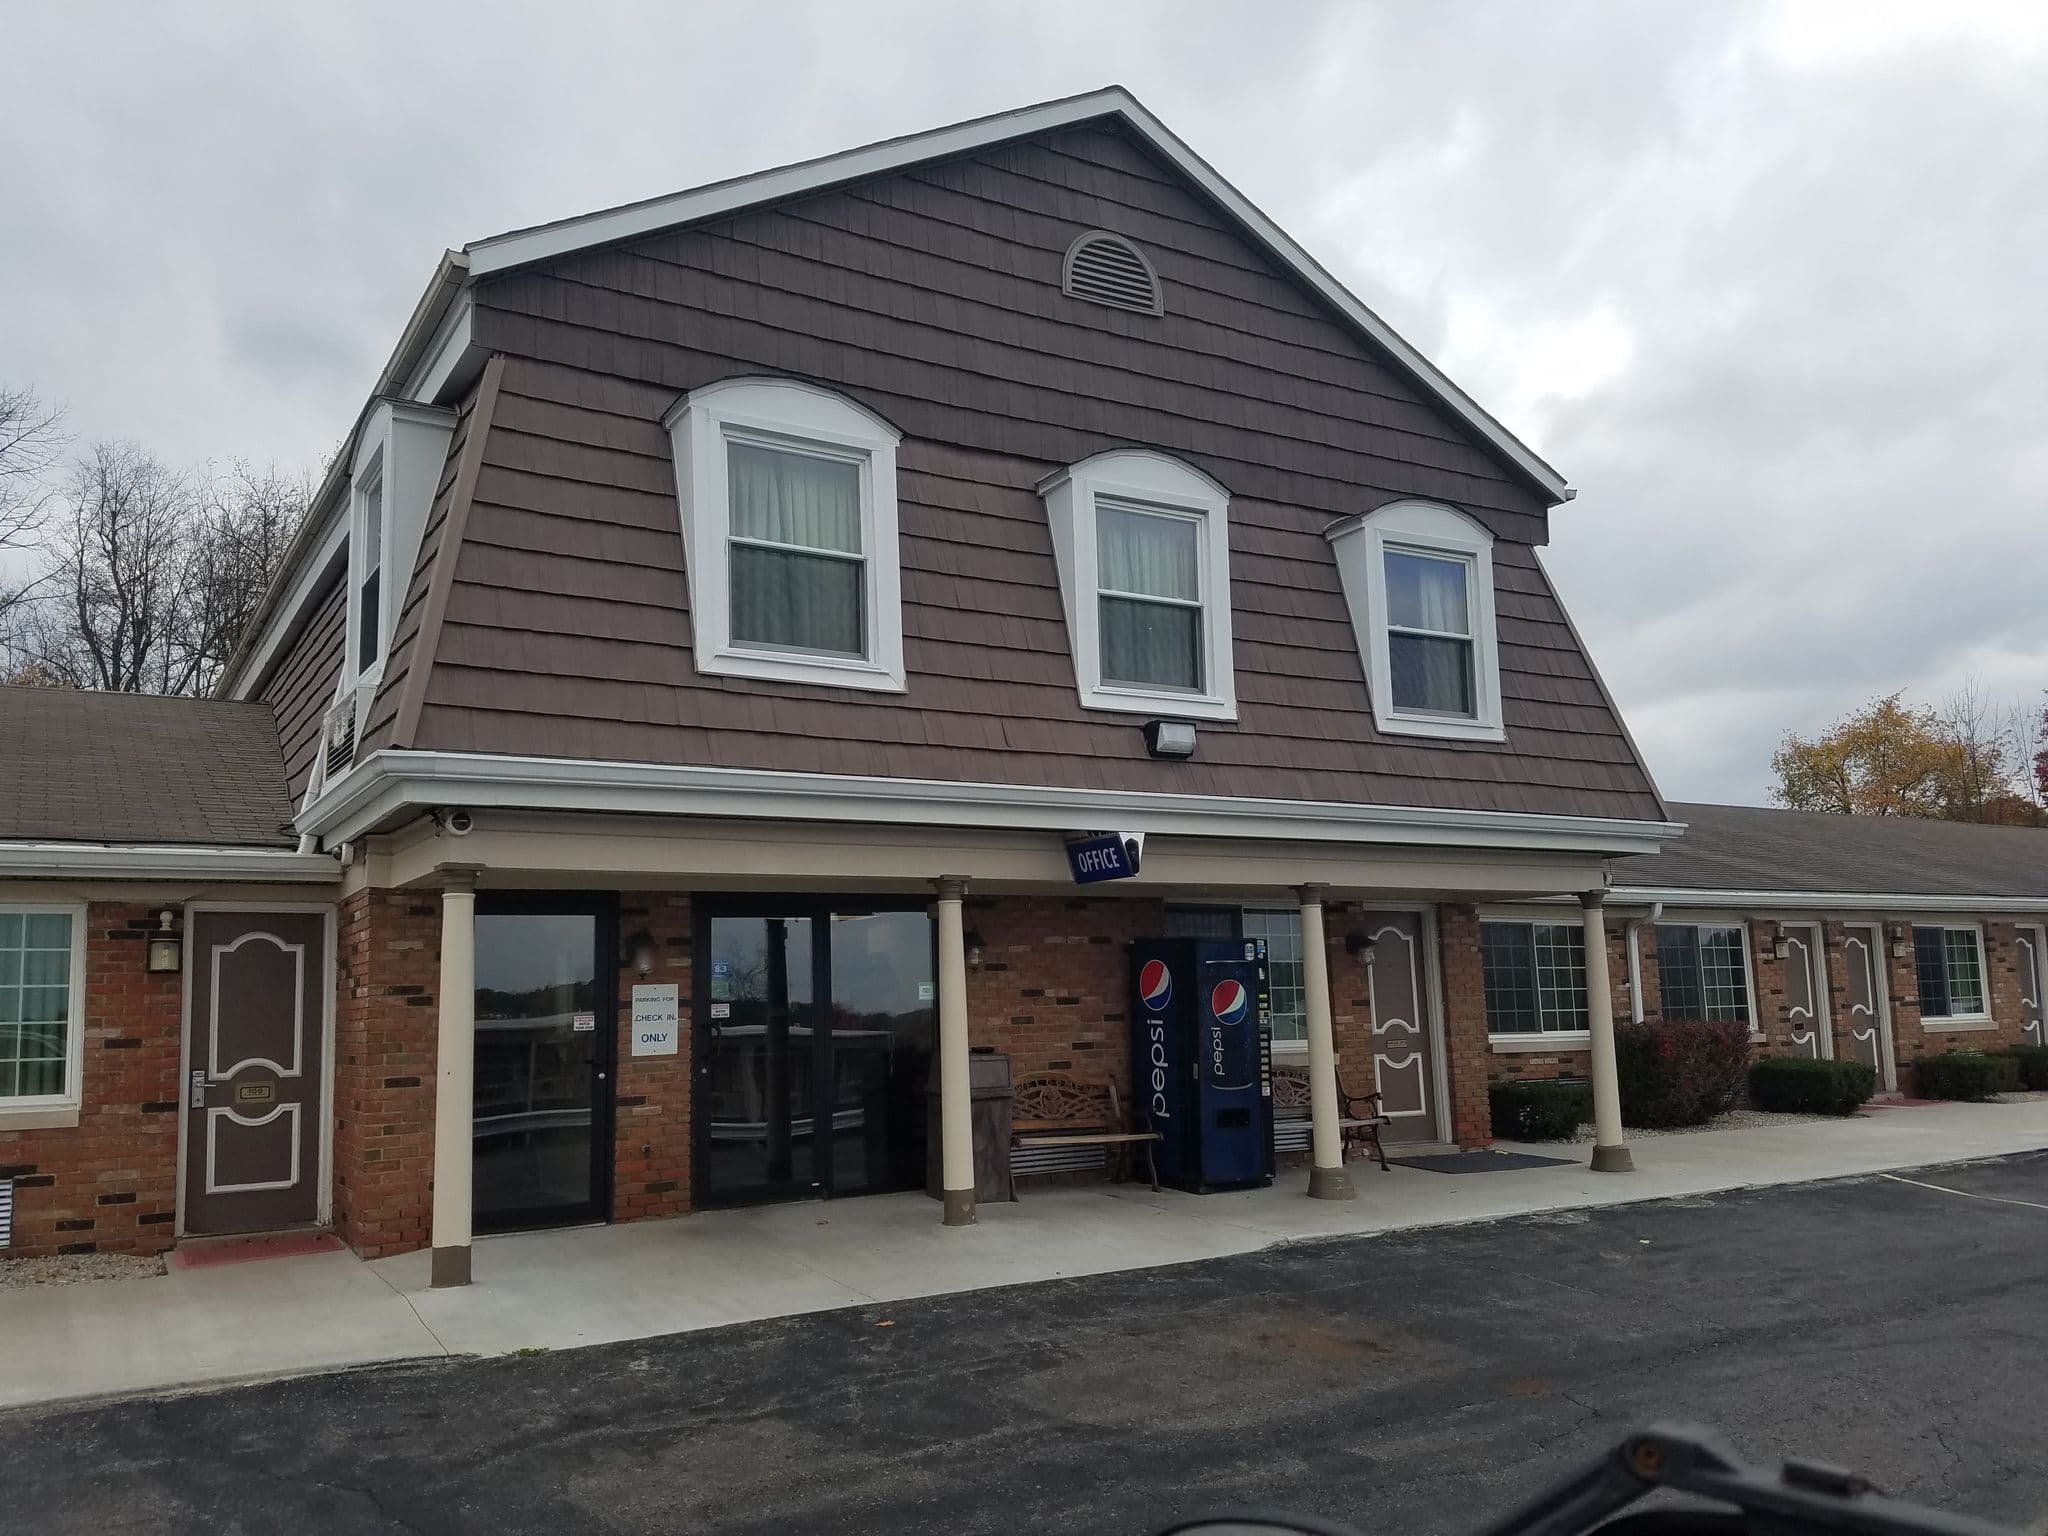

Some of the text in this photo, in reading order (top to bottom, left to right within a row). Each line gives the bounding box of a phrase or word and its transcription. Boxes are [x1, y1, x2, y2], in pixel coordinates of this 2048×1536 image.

[1078, 847, 1120, 873] OFFICE
[641, 1032, 668, 1043] ONLY
[1211, 1026, 1226, 1076] pepsi
[1147, 1019, 1170, 1118] pepsi
